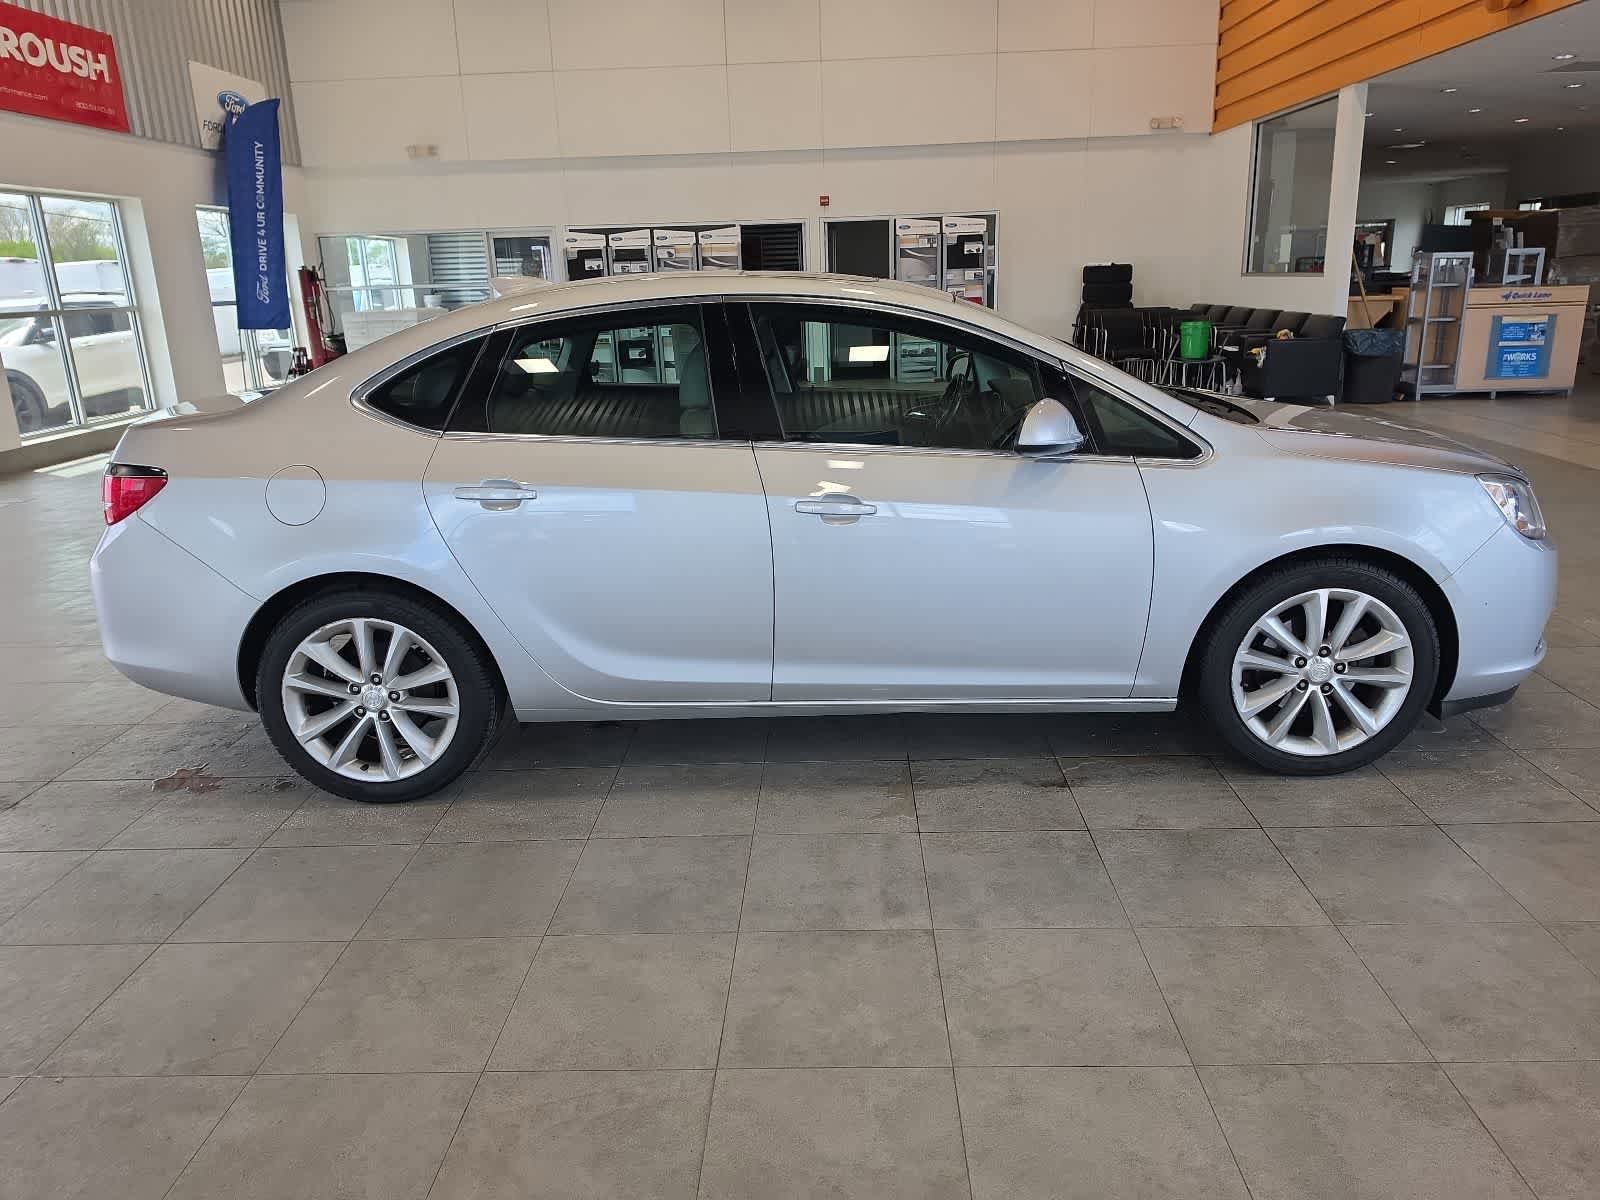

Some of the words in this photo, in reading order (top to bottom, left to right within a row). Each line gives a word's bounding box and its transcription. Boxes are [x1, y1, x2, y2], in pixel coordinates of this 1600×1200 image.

[0, 25, 112, 84] ROUSH
[254, 141, 265, 209] COMMUNITY
[256, 212, 266, 228] UR
[257, 229, 266, 237] 4
[257, 239, 268, 272] DRIVE
[256, 274, 270, 304] Ford
